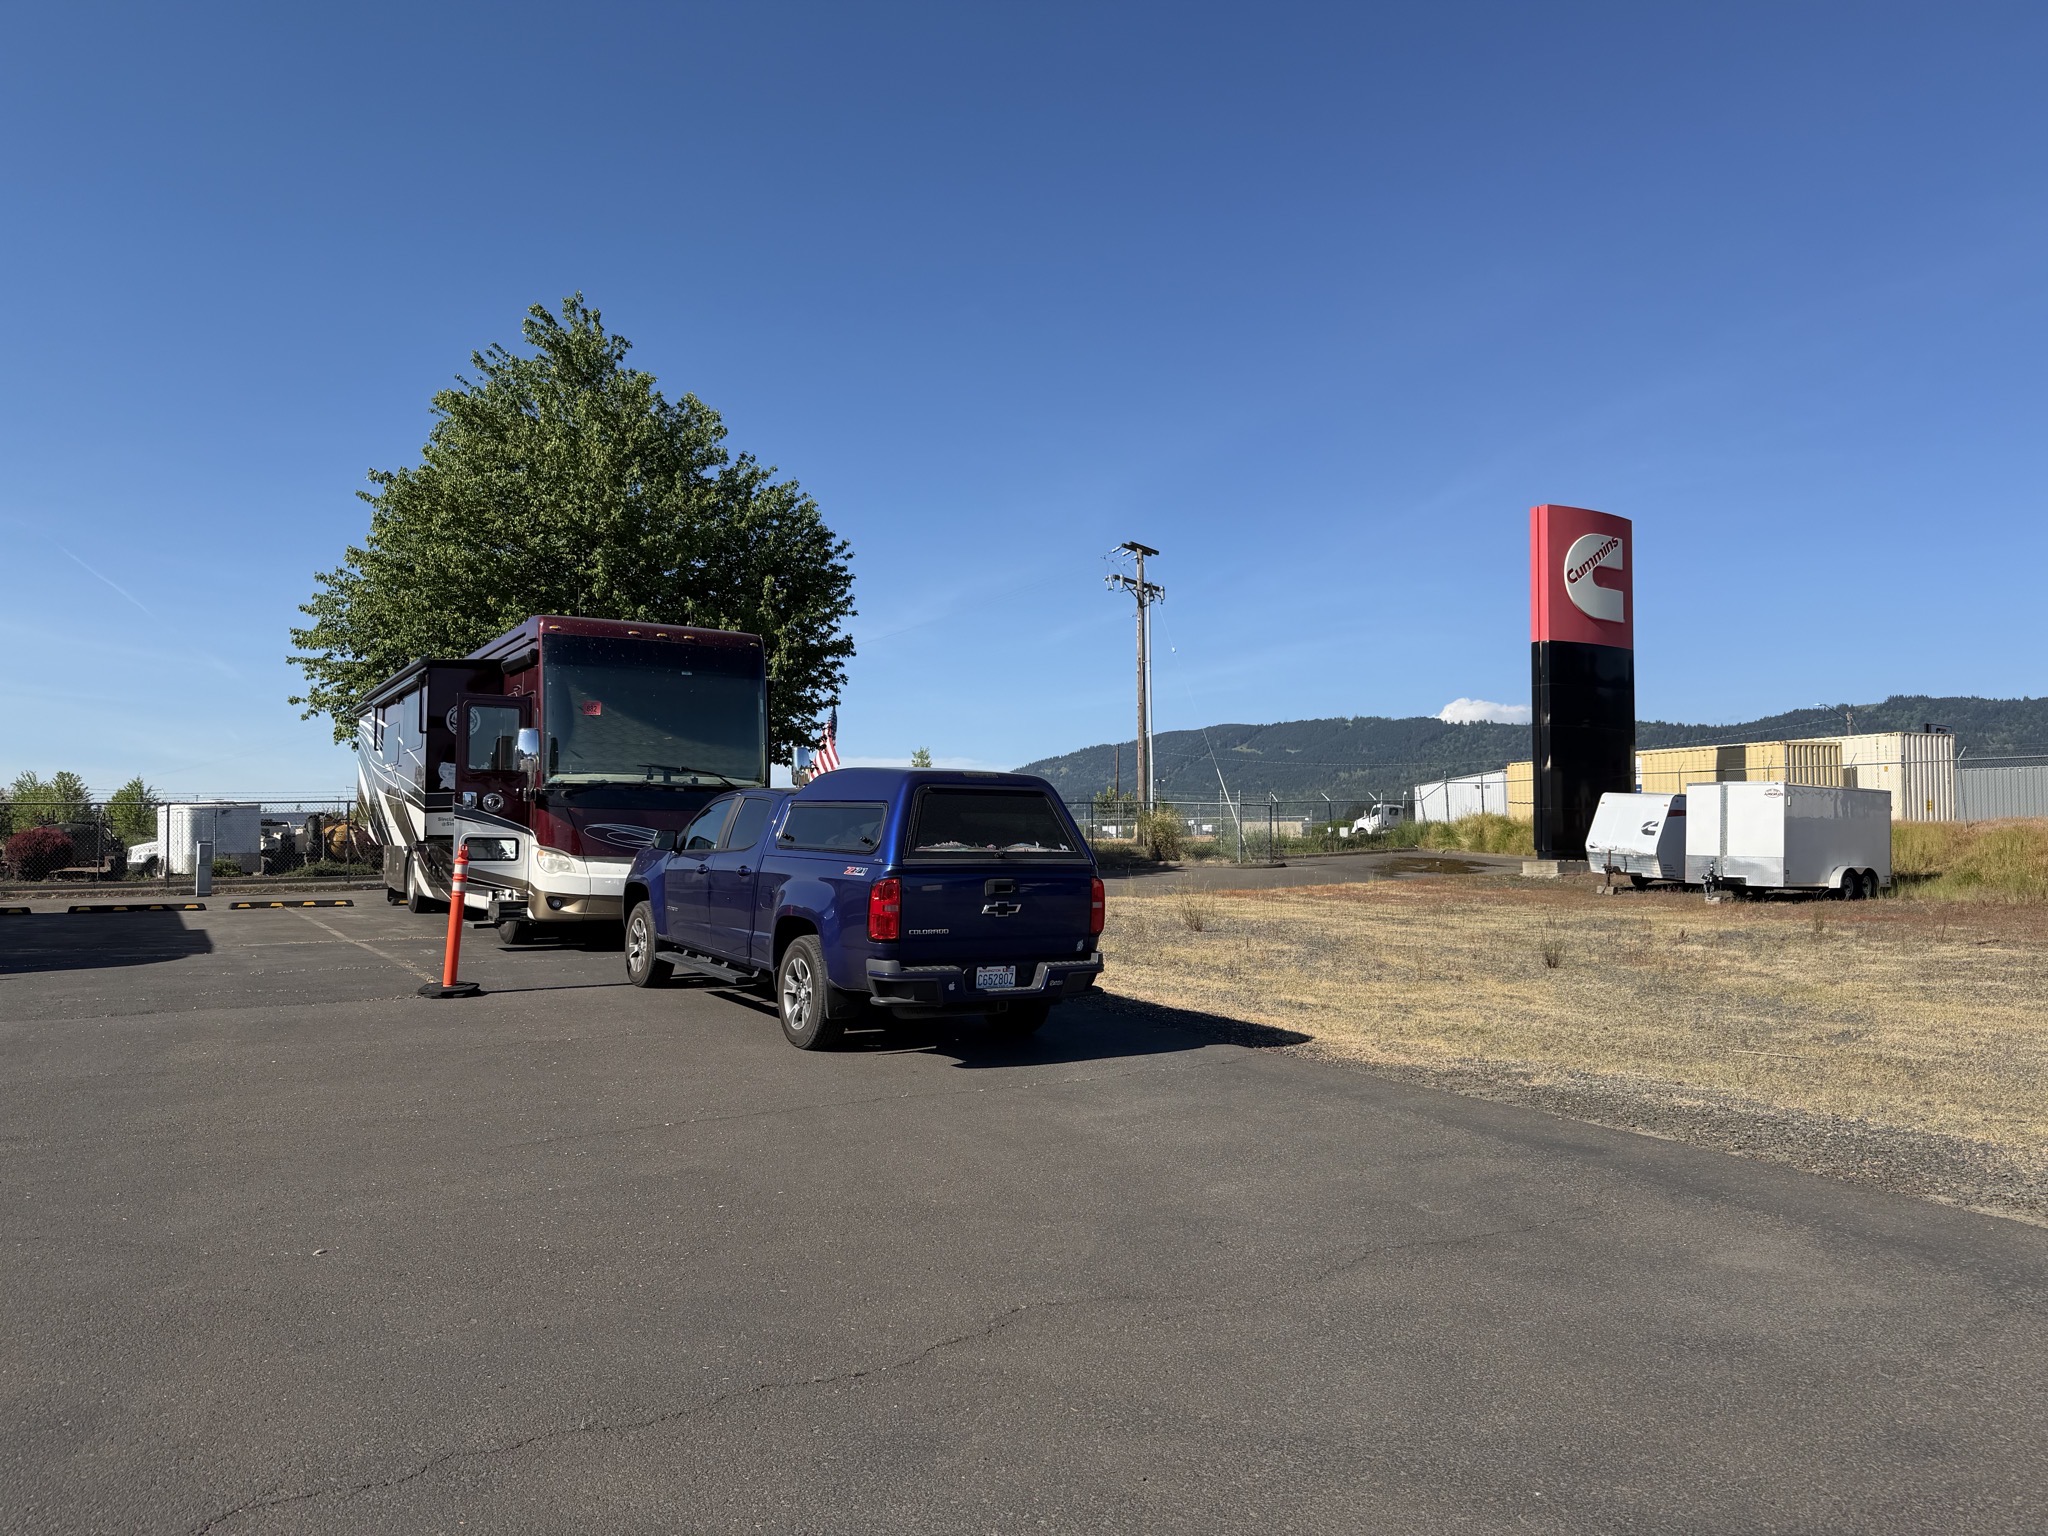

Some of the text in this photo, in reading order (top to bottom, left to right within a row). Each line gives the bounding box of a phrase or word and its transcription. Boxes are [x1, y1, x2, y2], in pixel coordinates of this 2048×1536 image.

[1566, 537, 1619, 584] Cummins
[843, 866, 869, 876] Z71
[977, 973, 1014, 986] C65280Z
